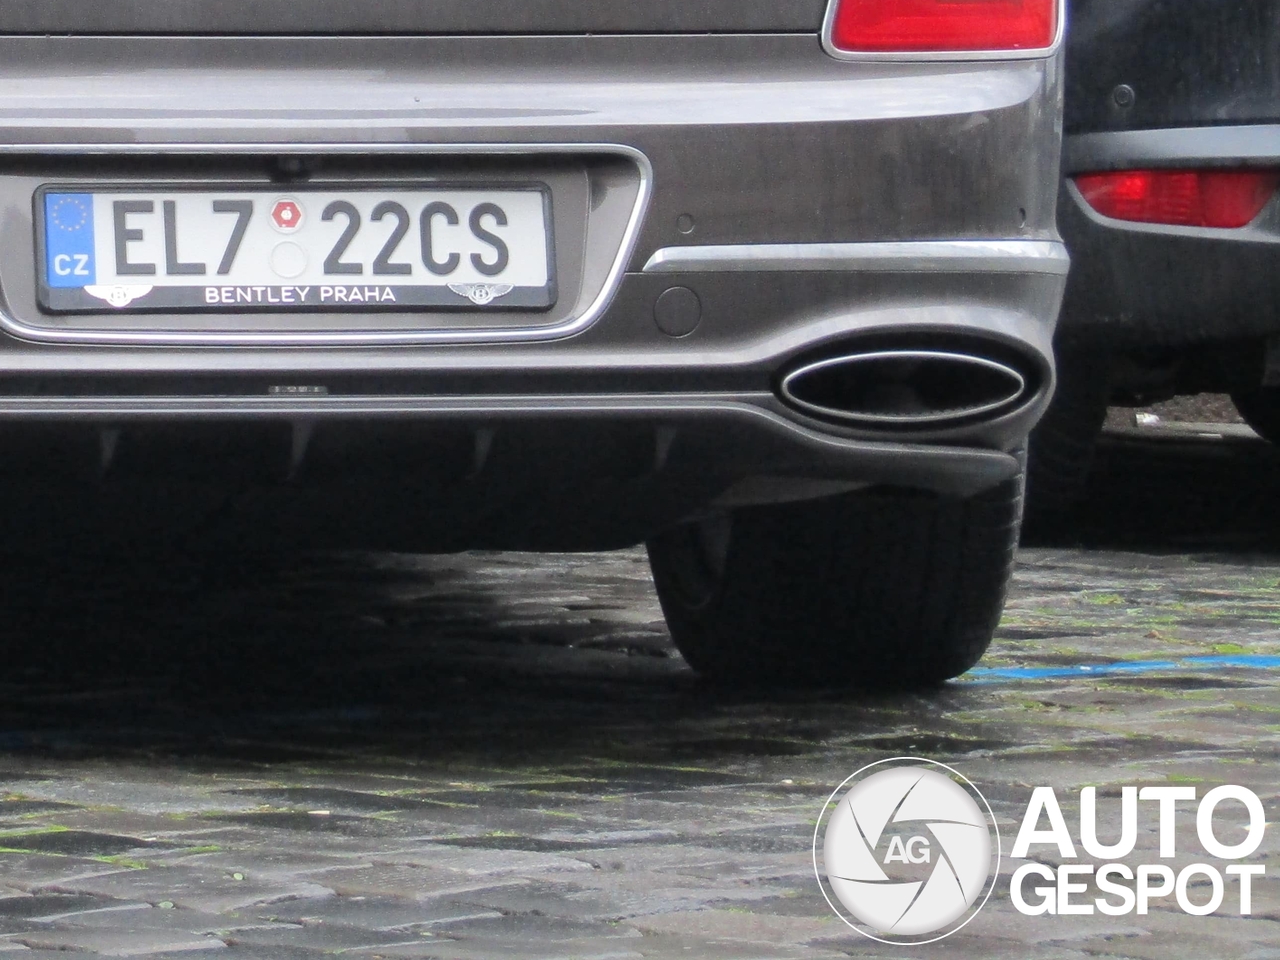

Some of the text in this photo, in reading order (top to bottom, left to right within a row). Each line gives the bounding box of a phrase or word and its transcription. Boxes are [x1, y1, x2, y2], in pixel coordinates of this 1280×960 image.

[113, 200, 510, 277] EL7 22CS
[54, 253, 89, 276] CZ
[205, 286, 397, 303] BENTLEY PRAHA
